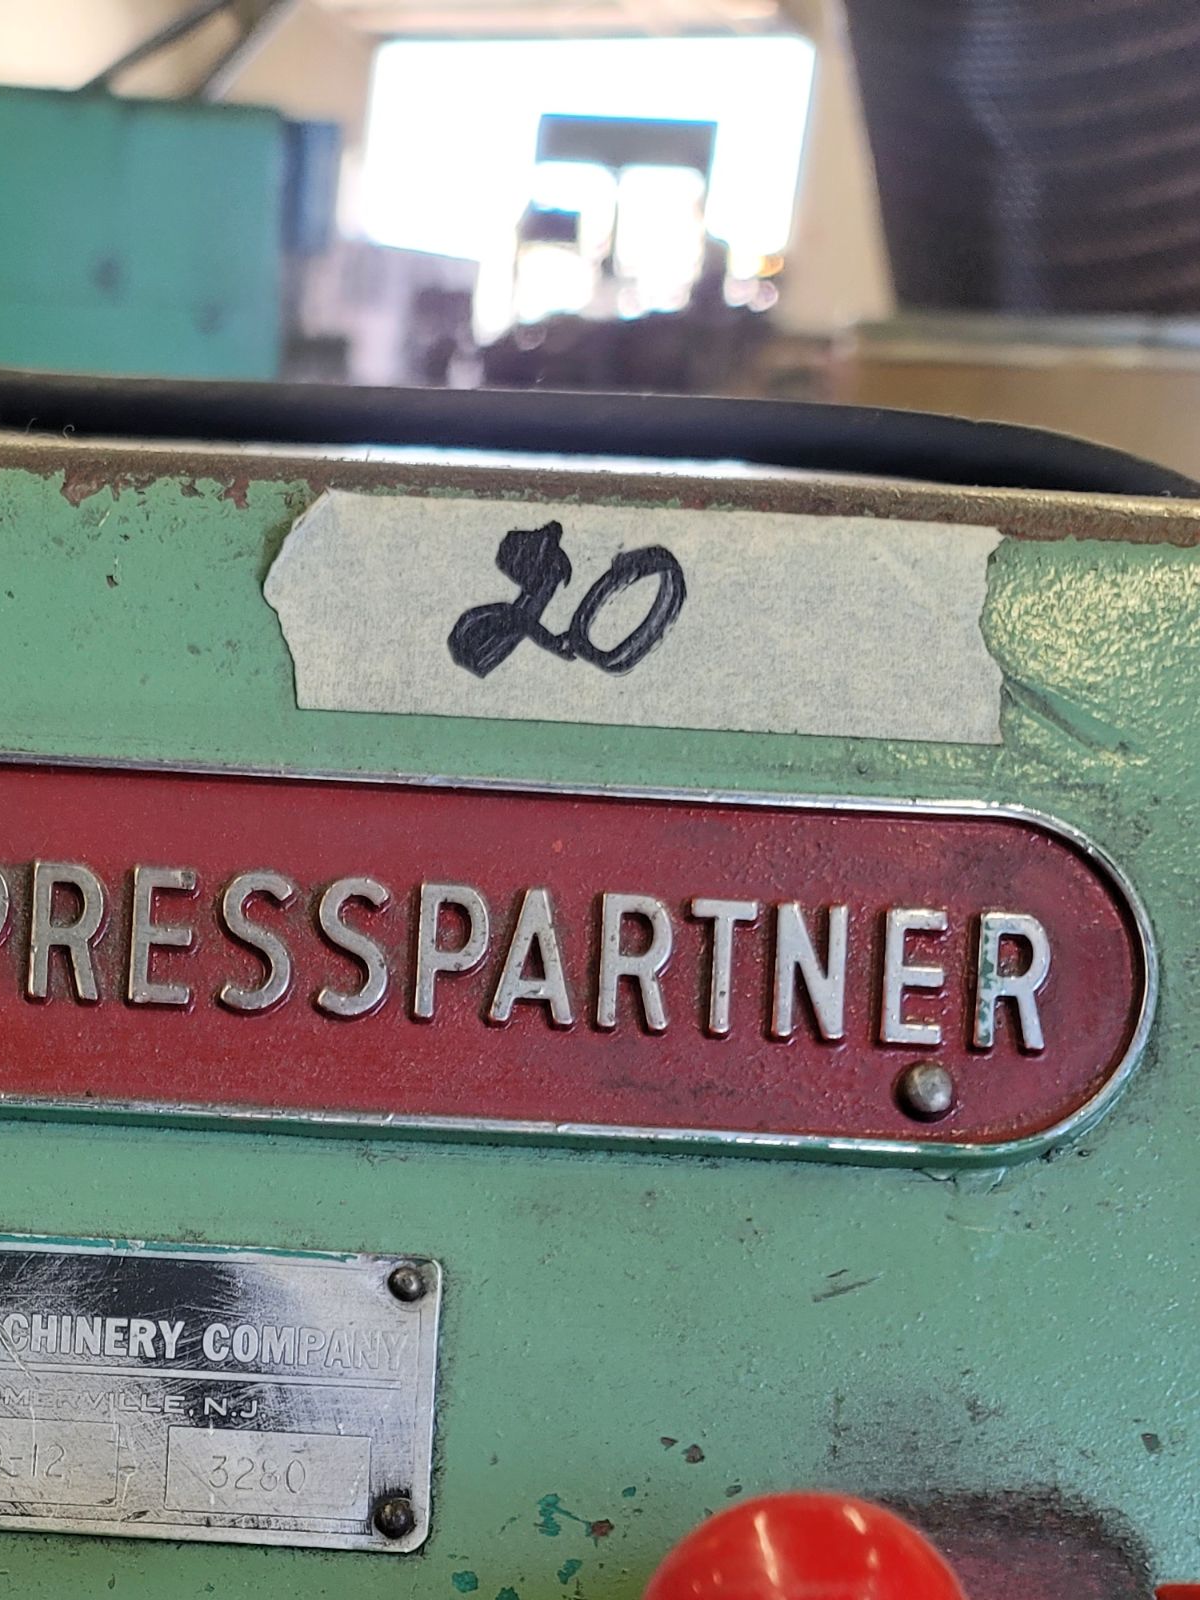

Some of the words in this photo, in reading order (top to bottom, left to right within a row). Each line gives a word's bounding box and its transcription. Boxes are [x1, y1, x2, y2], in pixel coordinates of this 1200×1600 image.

[447, 520, 687, 678] 20
[201, 1322, 410, 1371] COMPANY
[203, 1397, 267, 1418] N.J.
[208, 1455, 306, 1495] 3280
